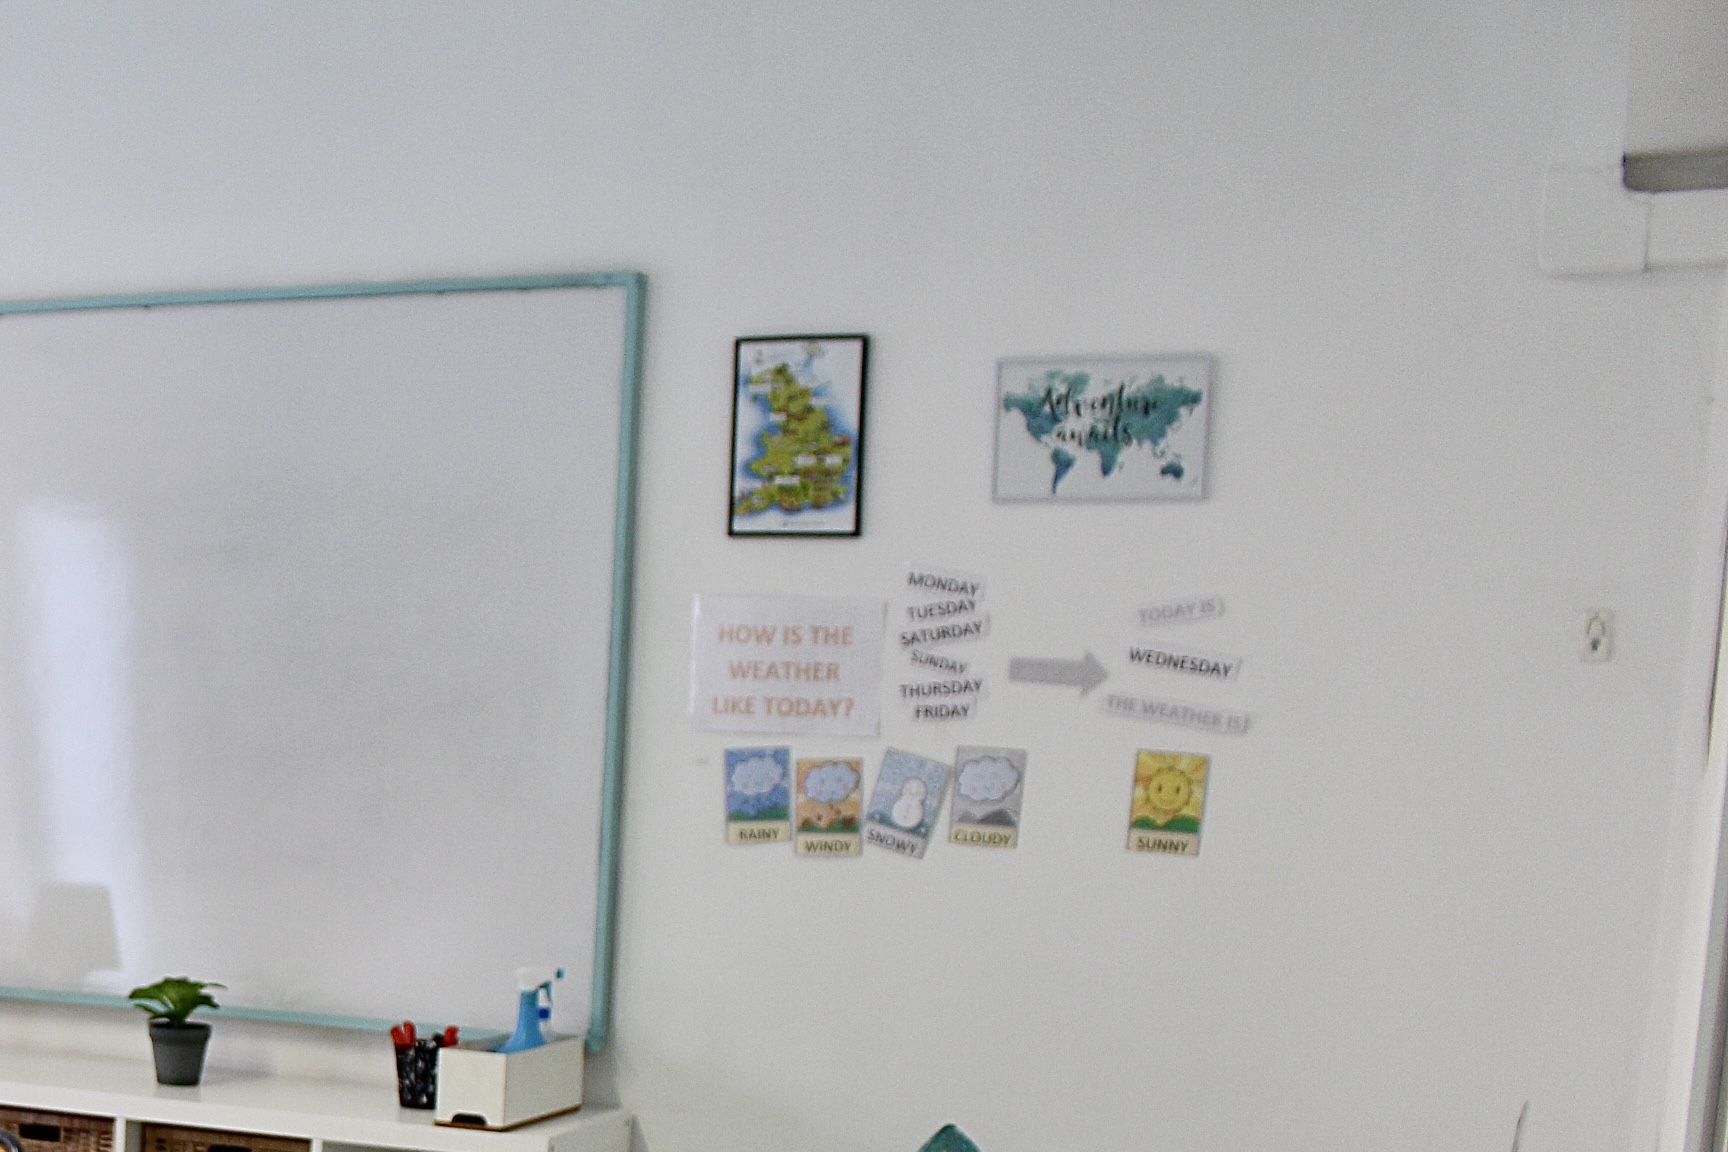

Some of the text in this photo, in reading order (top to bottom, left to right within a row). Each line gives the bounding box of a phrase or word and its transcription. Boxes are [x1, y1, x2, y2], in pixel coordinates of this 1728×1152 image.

[907, 571, 980, 597] MONDAY
[907, 599, 977, 621] TUESDAY
[1137, 600, 1195, 624] TODAY
[718, 623, 854, 646] HOW IS THE
[900, 620, 984, 646] SATURDAY
[728, 660, 842, 682] WEATHER
[910, 649, 969, 675] SUNDAY
[1128, 646, 1234, 678] WEDNESDAY
[899, 678, 984, 699] THURSDAY
[711, 696, 856, 718] LIKE TODAY?
[914, 704, 970, 720] FRIDAY
[739, 827, 780, 841] RAINY
[867, 829, 920, 855] SNOWY
[954, 829, 1013, 845] CLOUDY
[1137, 837, 1189, 853] SUNNY
[805, 839, 852, 853] WINDY
